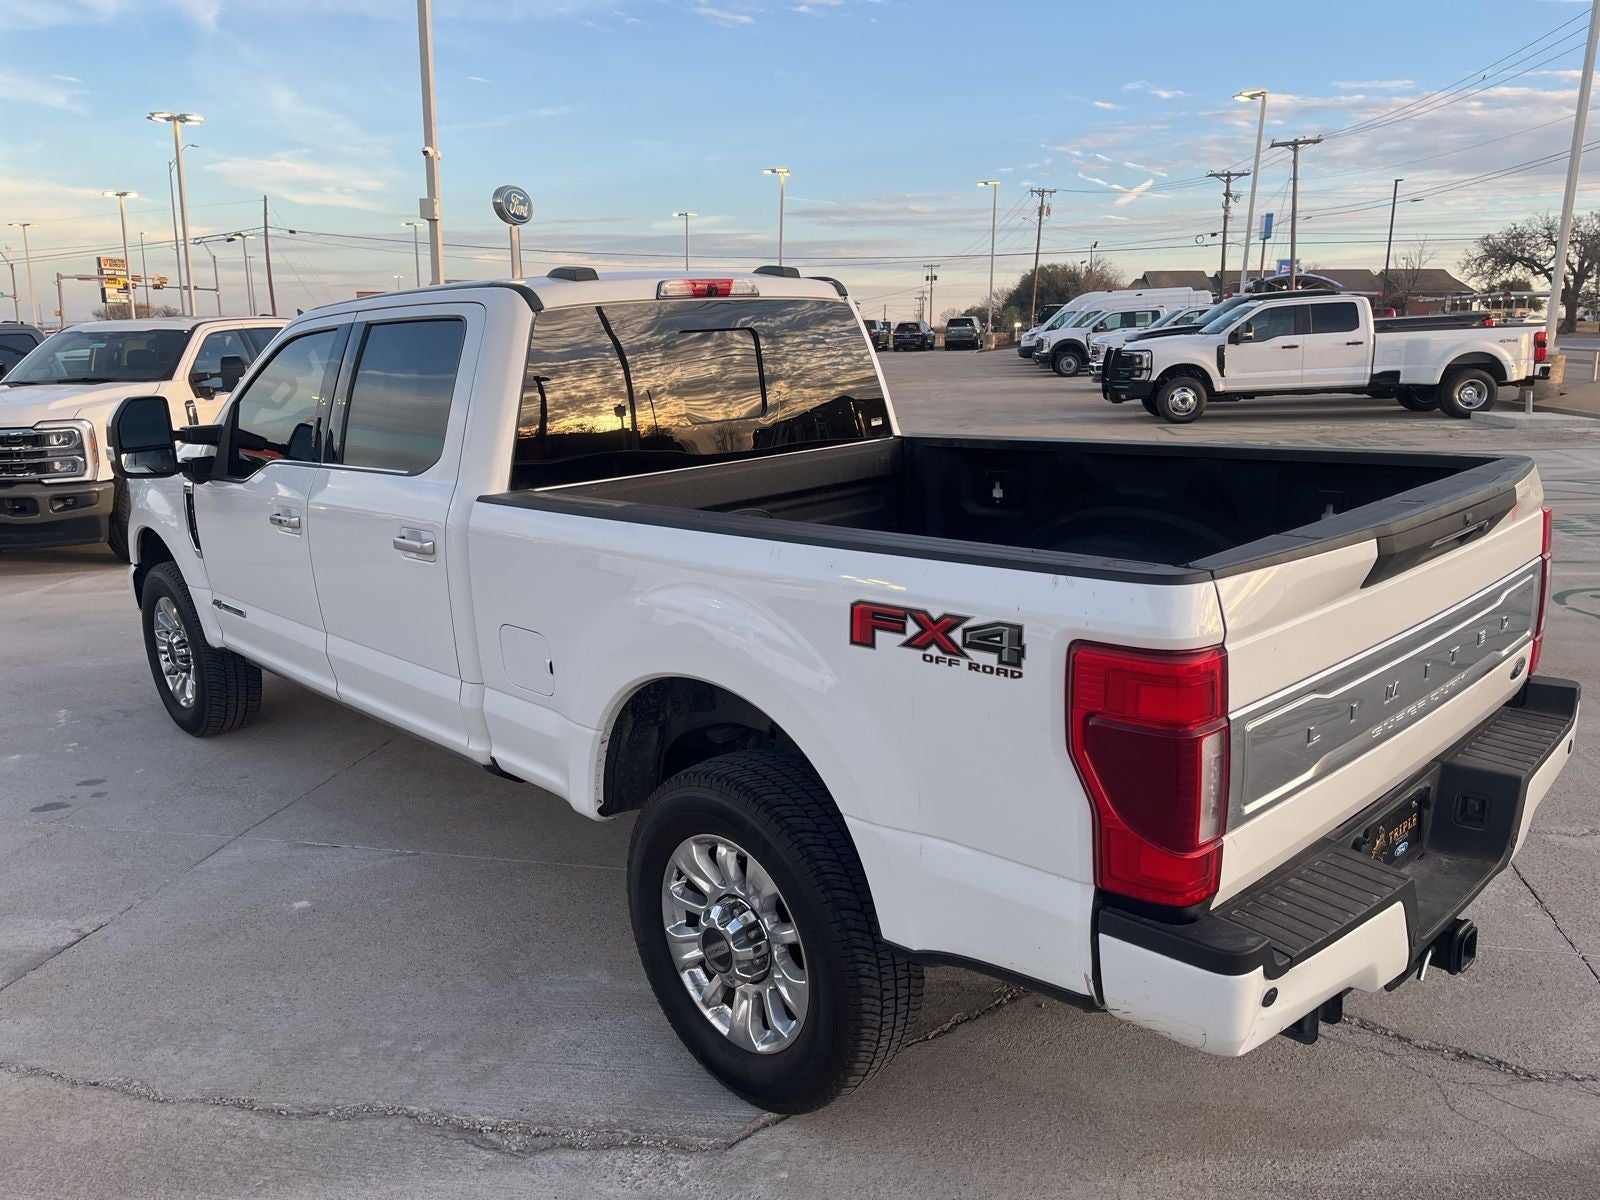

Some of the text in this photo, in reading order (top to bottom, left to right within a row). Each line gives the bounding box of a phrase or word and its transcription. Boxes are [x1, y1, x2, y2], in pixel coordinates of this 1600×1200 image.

[509, 193, 529, 218] Ford
[849, 599, 1026, 670] FX4
[921, 652, 1024, 680] OFF ROAD
[1306, 615, 1509, 748] LIMITED
[1371, 673, 1466, 739] SUPER DUTY
